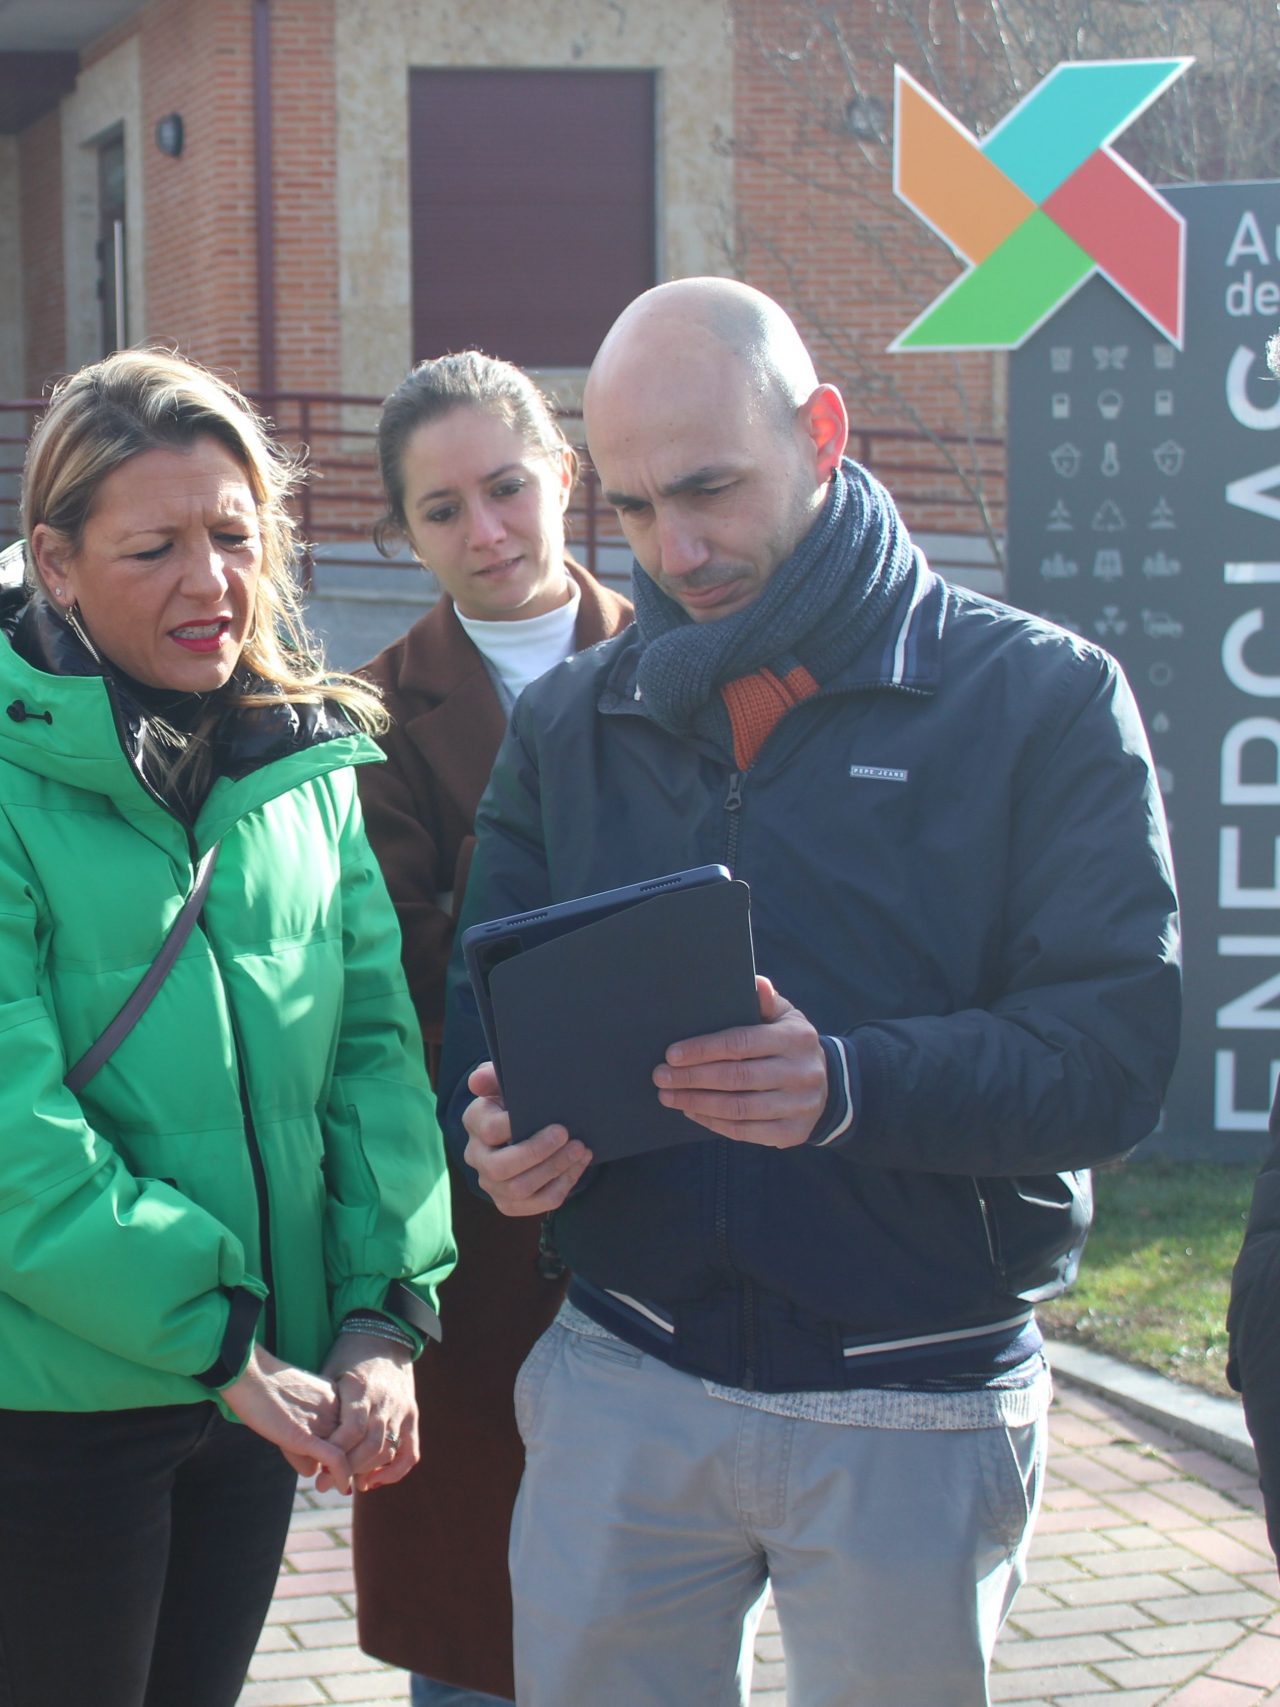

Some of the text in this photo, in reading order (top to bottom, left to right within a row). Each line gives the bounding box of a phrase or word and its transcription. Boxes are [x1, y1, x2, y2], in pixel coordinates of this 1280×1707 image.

[1225, 209, 1280, 268] A
[1225, 270, 1280, 318] de
[877, 770, 904, 778] JEANS
